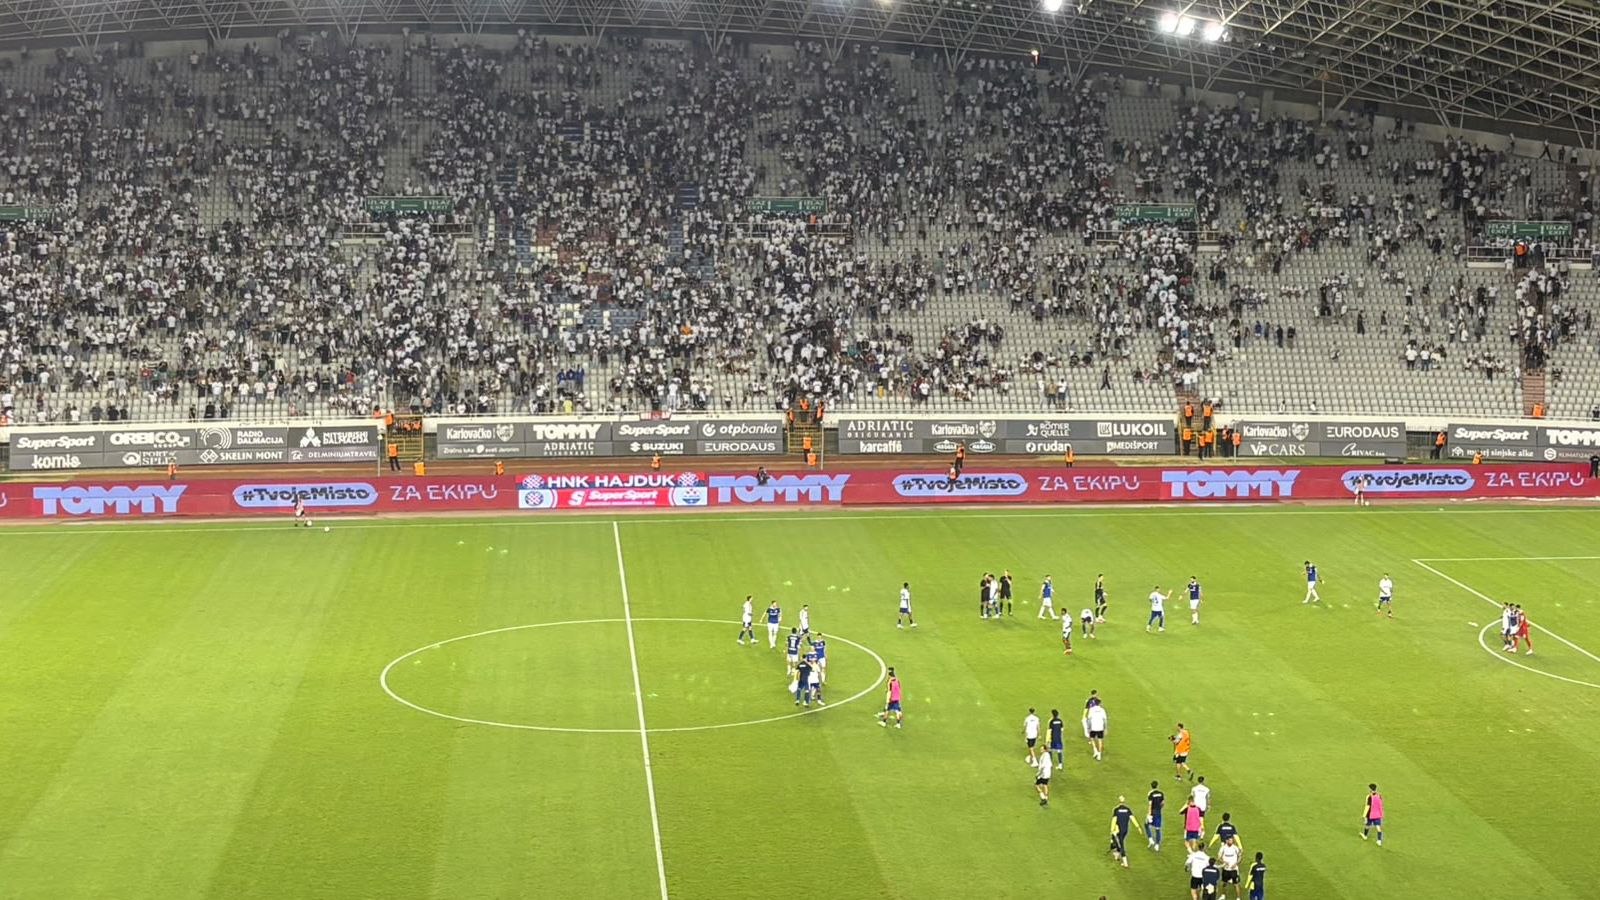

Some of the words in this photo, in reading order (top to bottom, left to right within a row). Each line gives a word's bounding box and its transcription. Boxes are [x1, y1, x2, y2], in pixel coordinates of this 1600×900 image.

[533, 424, 602, 440] TOMMY
[618, 424, 691, 437] SuperSport
[847, 420, 914, 431] ADRIATIC
[1113, 423, 1167, 436] LUKOIL
[1326, 426, 1399, 438] EURODAUS
[109, 431, 180, 446] ORBICO
[237, 430, 264, 438] RADIO
[237, 437, 284, 445] DALMACIJA
[1040, 430, 1070, 438] QUELLE
[1454, 427, 1530, 441] SuperSport
[16, 435, 96, 450] SuperSport
[544, 442, 594, 451] ADRIATIC
[641, 442, 684, 451] SUZUKI
[705, 442, 776, 452] EURODAUS
[1268, 443, 1306, 456] CARS
[220, 451, 253, 461] SKELIN
[255, 450, 284, 460] MONT
[547, 475, 589, 489] HNK
[595, 474, 676, 488] HAJDUK
[902, 476, 1021, 492] #TvojeMisto
[1038, 476, 1069, 491] ZA
[1073, 475, 1140, 491] EKIPU
[1161, 470, 1301, 497] TOMMY
[1484, 472, 1514, 487] ZA
[1519, 472, 1585, 487] EKIPU
[243, 486, 370, 503] #TvojeMisto
[389, 485, 422, 501] ZA
[427, 484, 498, 500] EKIPU
[709, 473, 851, 503] TOMMY
[32, 484, 188, 515] TOMMY
